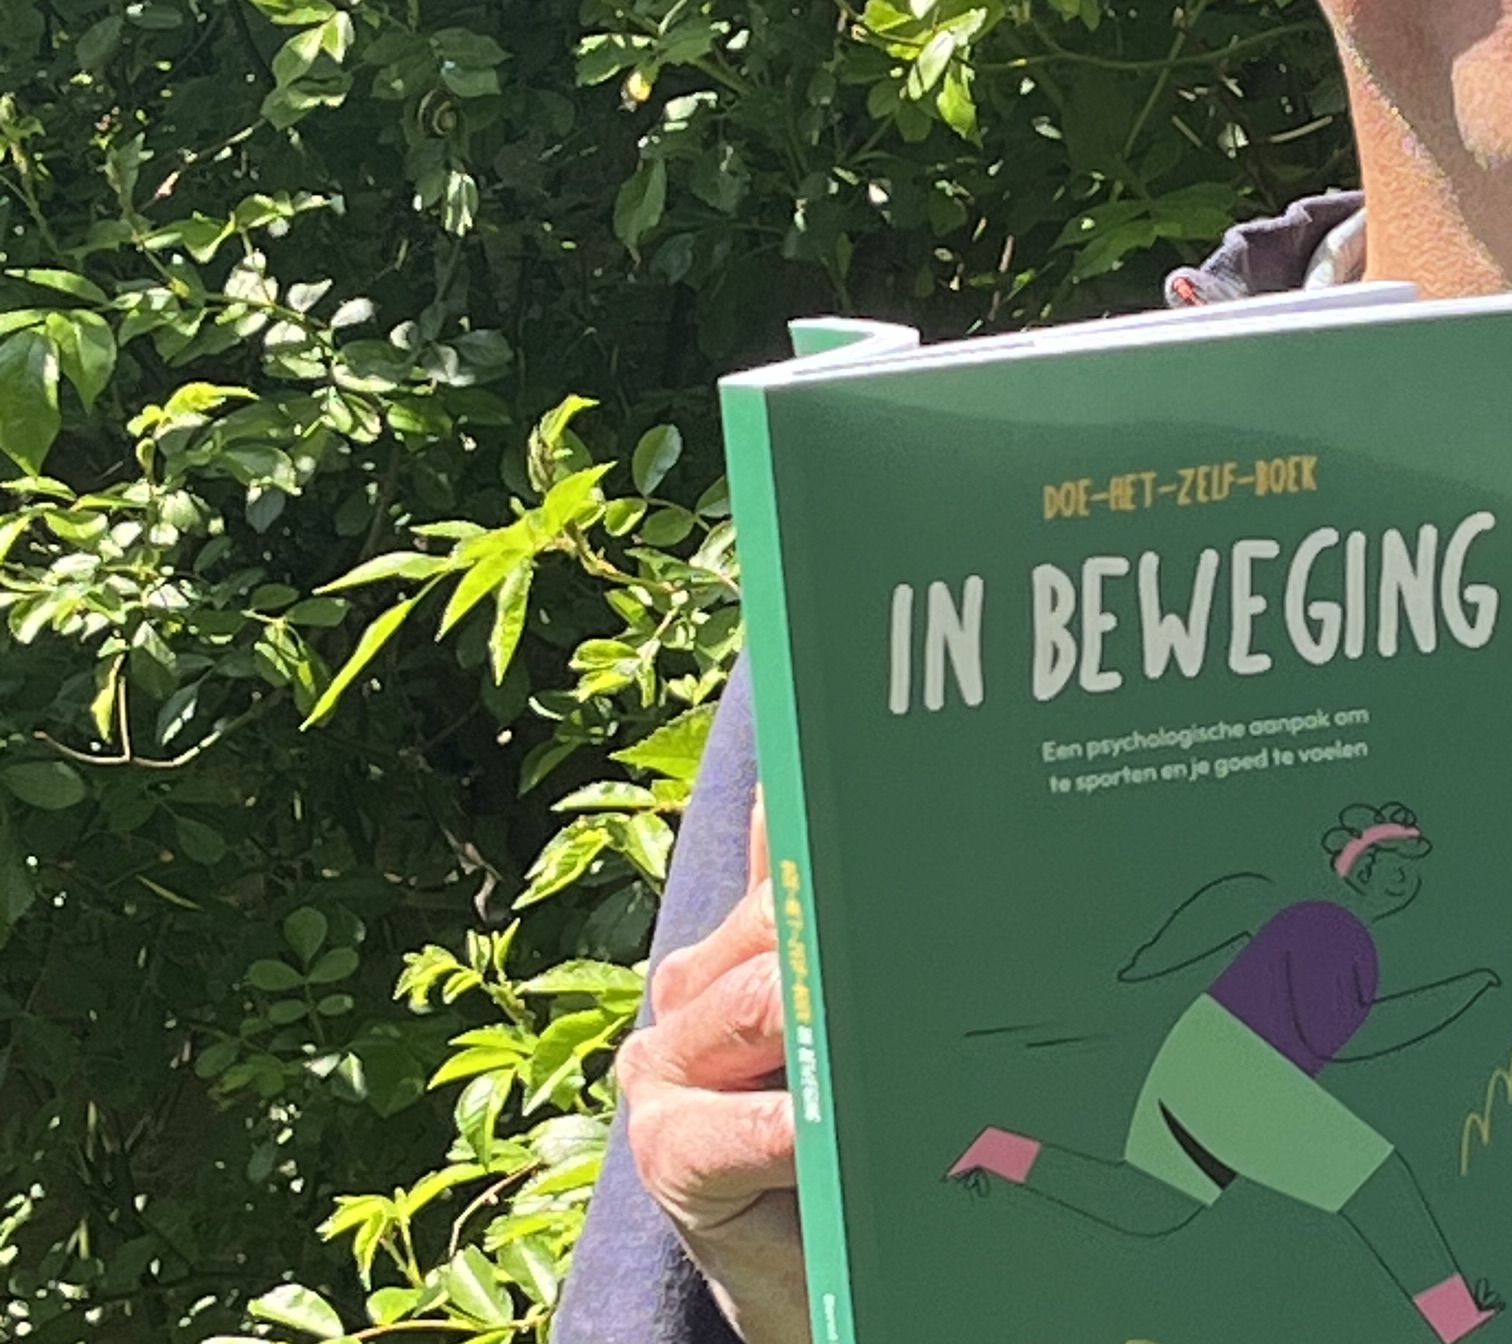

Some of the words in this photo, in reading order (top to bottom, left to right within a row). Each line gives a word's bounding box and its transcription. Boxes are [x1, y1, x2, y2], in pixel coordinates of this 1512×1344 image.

[1043, 455, 1318, 520] DOE-HET-ZELF-BOEK
[889, 575, 984, 715] IN
[1032, 511, 1498, 701] BEWEGING
[1041, 740, 1083, 762] Een
[1086, 720, 1246, 761] psychologische
[1248, 709, 1331, 736] aanpak
[1334, 707, 1370, 726] om
[1049, 775, 1072, 793] te
[1075, 766, 1158, 794] sporten
[1160, 763, 1188, 780] en
[1188, 757, 1210, 782] je
[1214, 747, 1269, 778] goed
[1272, 748, 1294, 766] te
[1297, 740, 1368, 763] voelen
